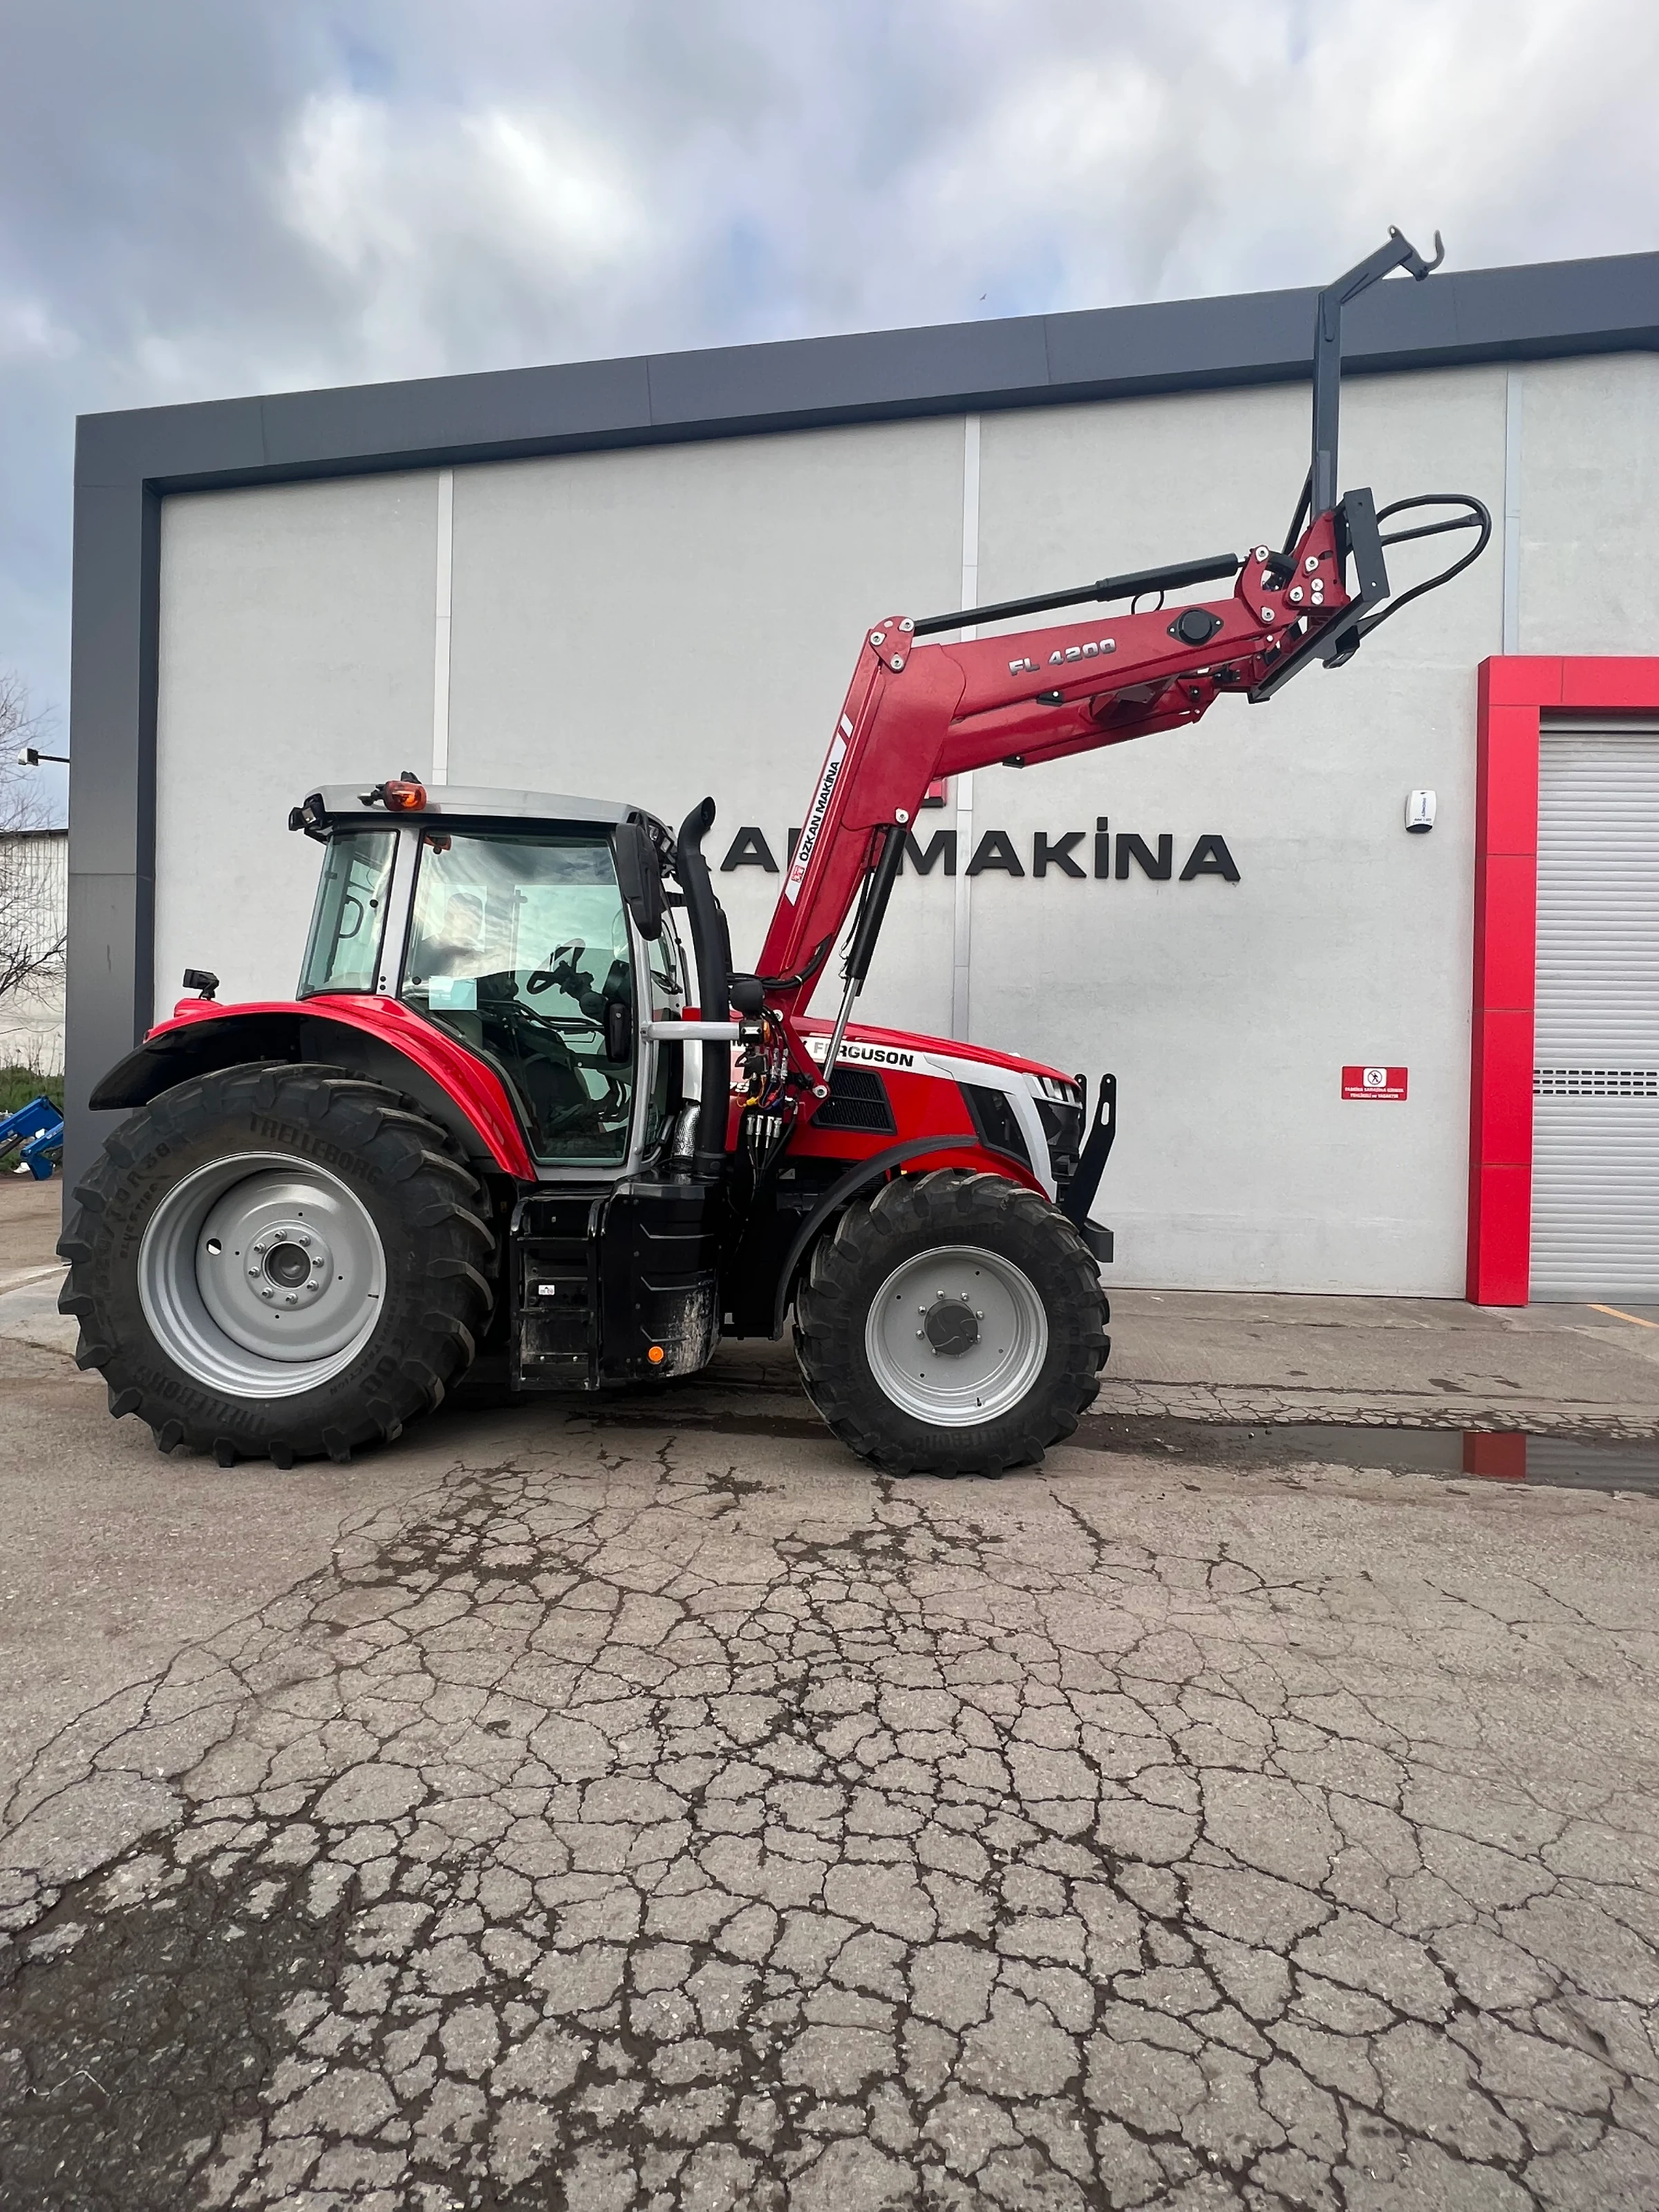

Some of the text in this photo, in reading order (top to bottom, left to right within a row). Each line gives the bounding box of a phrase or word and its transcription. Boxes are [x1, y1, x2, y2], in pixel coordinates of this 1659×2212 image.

[1008, 638, 1116, 676] FL 4200
[799, 761, 840, 862] ÖZKAN MAKİNA
[897, 816, 1241, 881] MAKİNA
[813, 1042, 915, 1067] FRGUSON
